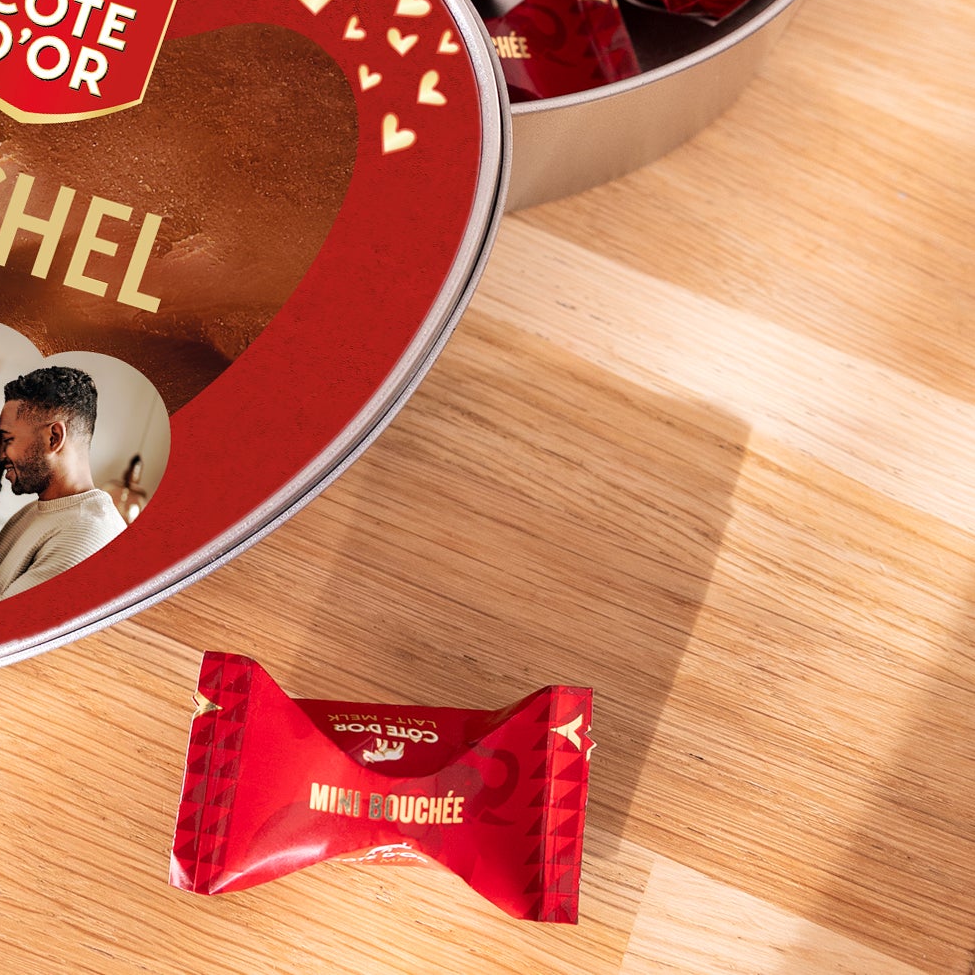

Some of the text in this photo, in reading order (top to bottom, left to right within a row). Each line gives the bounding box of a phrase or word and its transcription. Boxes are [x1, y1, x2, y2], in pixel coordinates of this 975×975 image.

[327, 713, 437, 729] LAIT MELK
[385, 724, 439, 744] CÔTE
[309, 781, 465, 825] MINI BOUCHÉE
